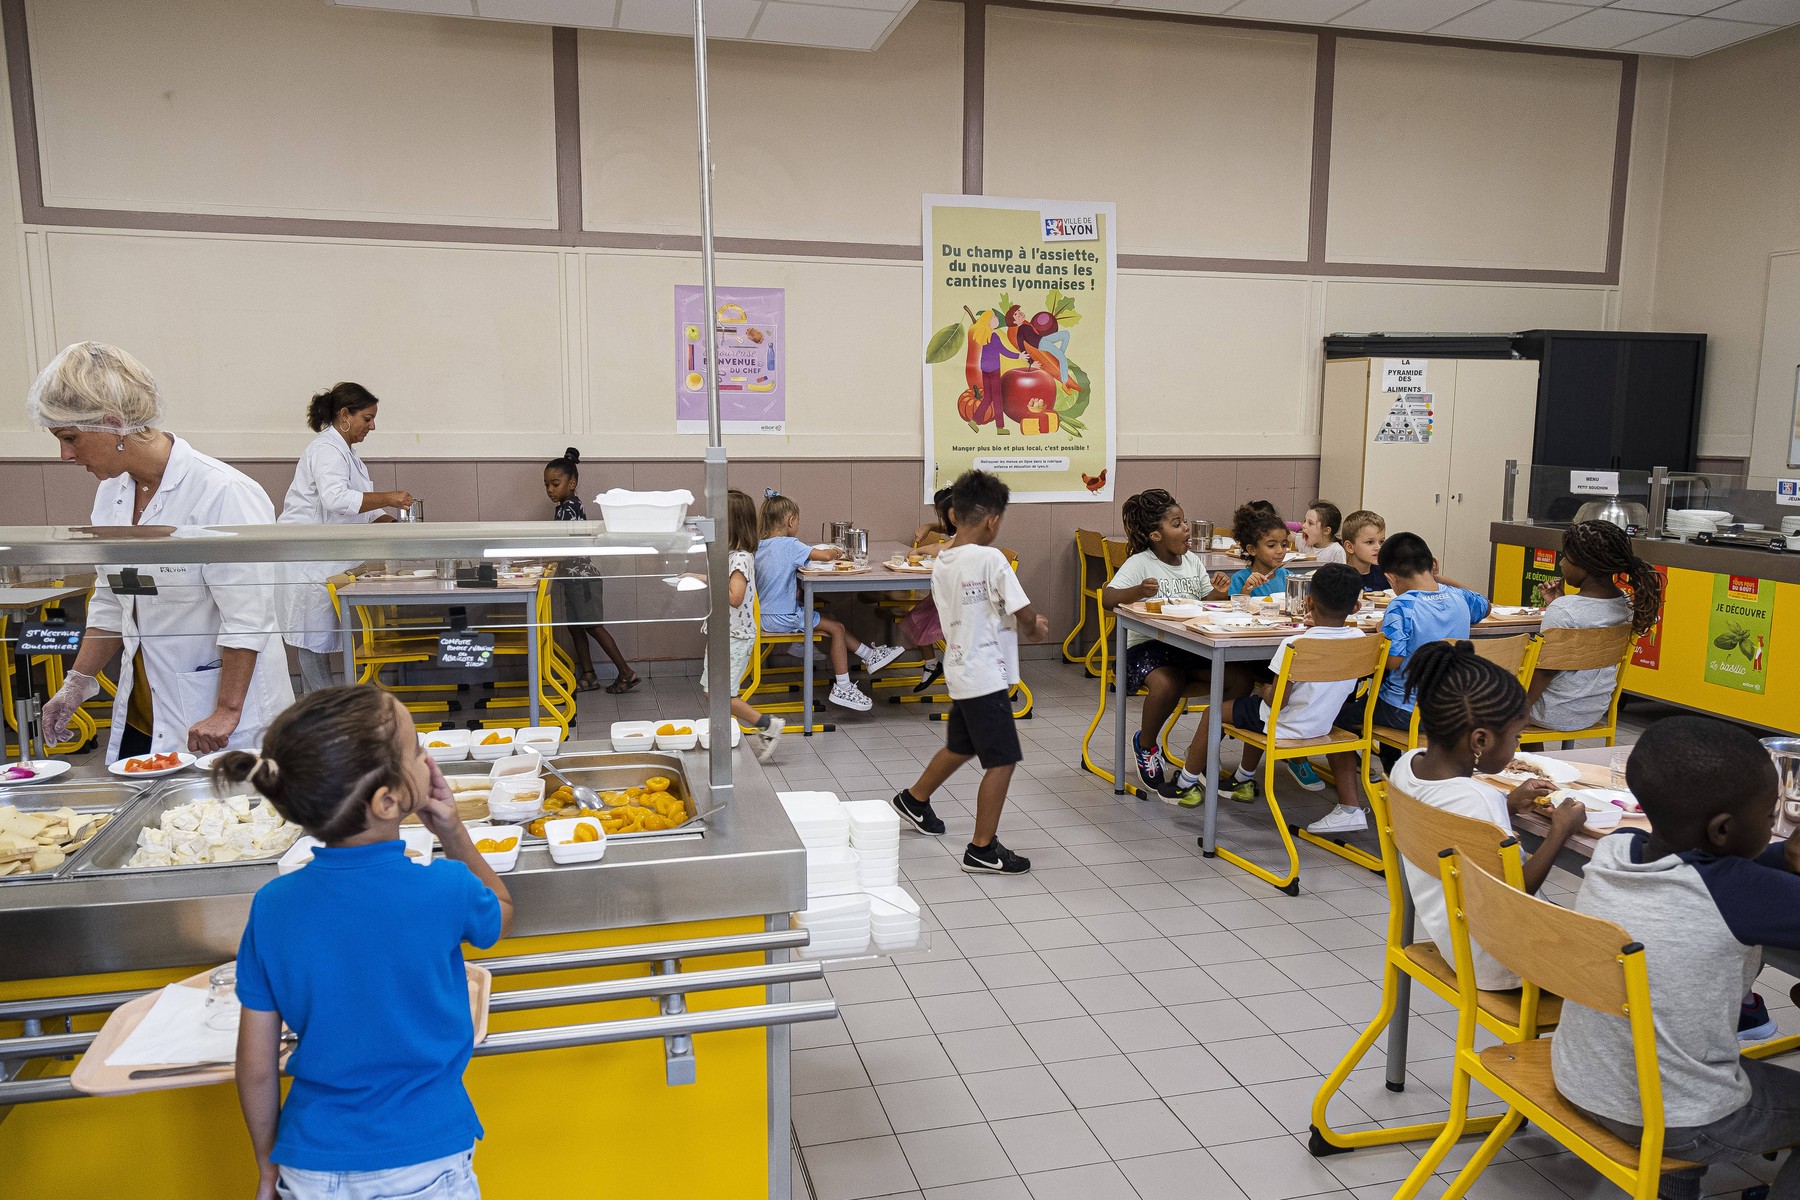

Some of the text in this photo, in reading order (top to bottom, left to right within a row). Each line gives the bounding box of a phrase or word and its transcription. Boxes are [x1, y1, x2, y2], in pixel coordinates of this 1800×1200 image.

[1064, 225, 1092, 235] LYON
[942, 244, 1099, 264] Du champ à l'assiette,
[949, 260, 1092, 276] du nouveau dans les
[946, 275, 1095, 291] cantines lyonnaises !
[1716, 603, 1766, 619] JE DÉCOUVRE
[1720, 661, 1746, 675] basilic
